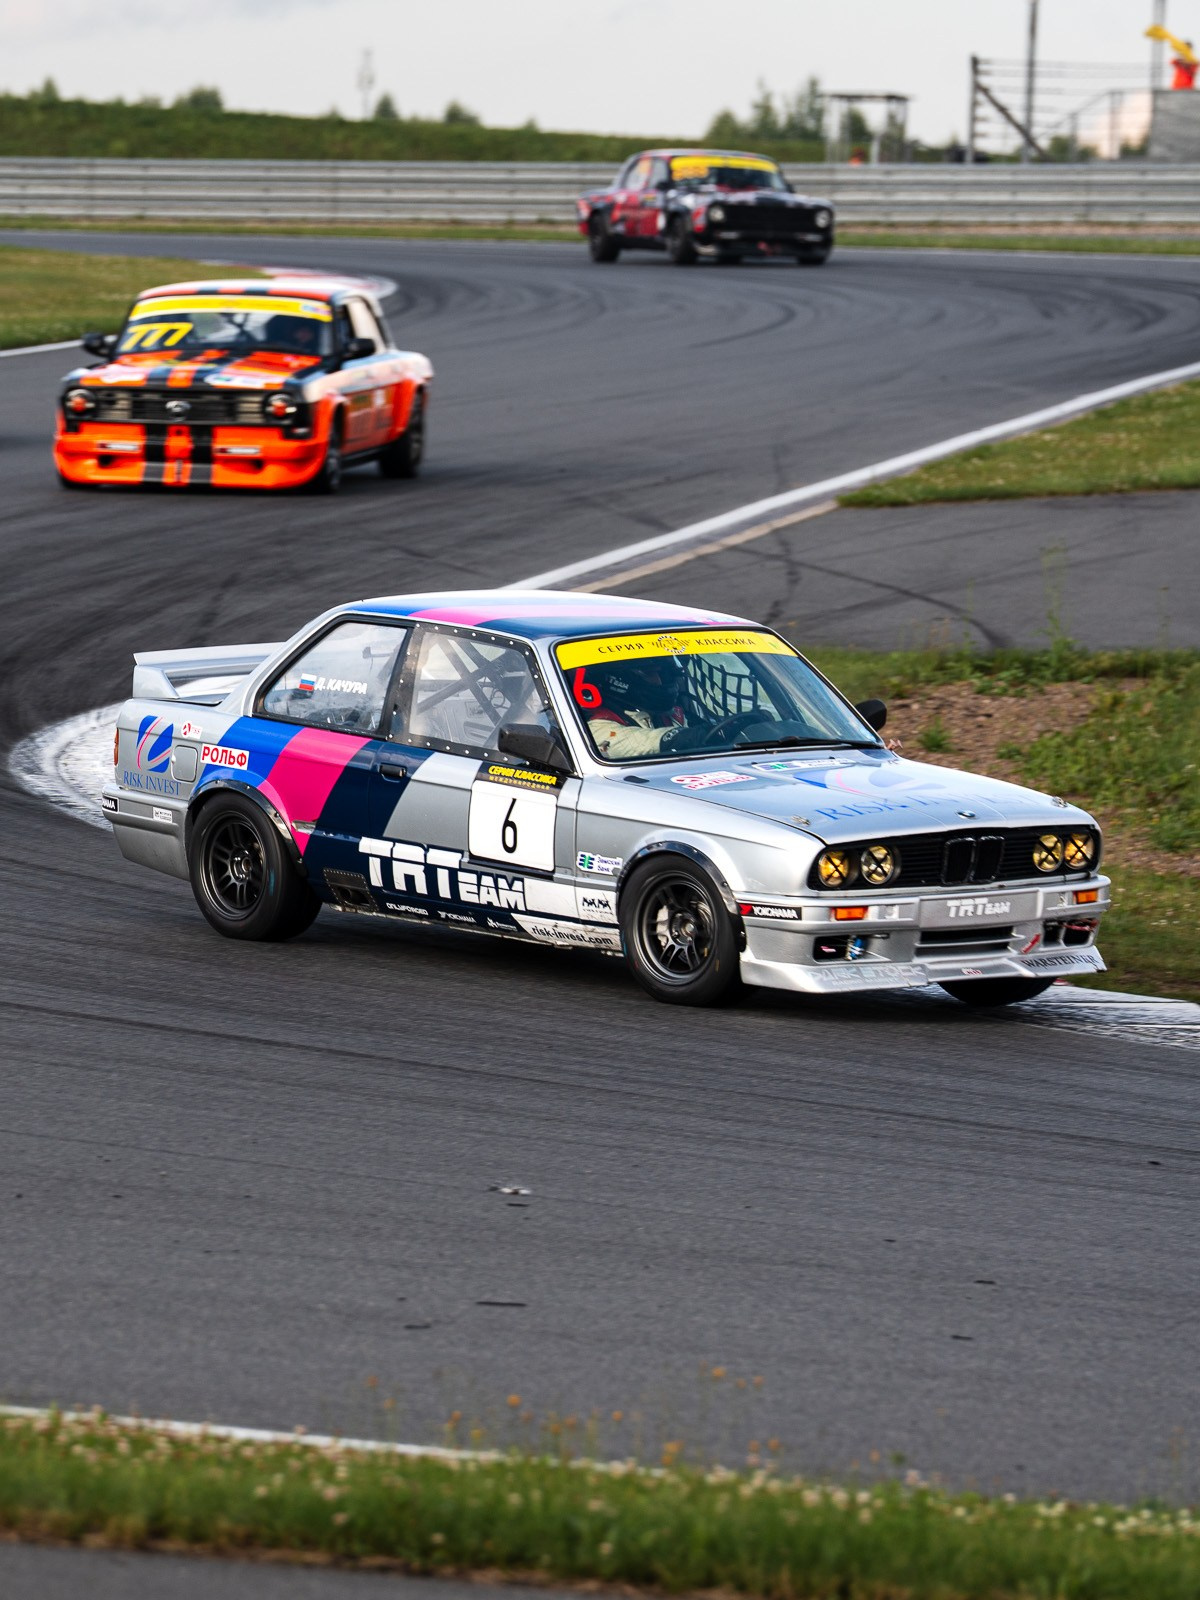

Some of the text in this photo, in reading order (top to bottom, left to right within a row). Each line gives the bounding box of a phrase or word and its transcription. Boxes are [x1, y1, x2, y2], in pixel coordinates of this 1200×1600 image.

[120, 322, 193, 351] 777
[597, 638, 757, 654] СЕРИЯ КЛАССИКА
[326, 678, 368, 695] КАЧУРА
[573, 667, 602, 709] 6
[201, 746, 247, 767] РОЛЬФ
[123, 770, 182, 796] RISK INVEST
[488, 765, 558, 786] СЕРИЯ КЛАССИКА
[815, 798, 907, 820] RISK
[501, 797, 518, 854] 6
[752, 905, 799, 919] YOKOHAMA
[531, 925, 614, 945] risk-invest.com
[1020, 954, 1100, 970] WARSTEINER
